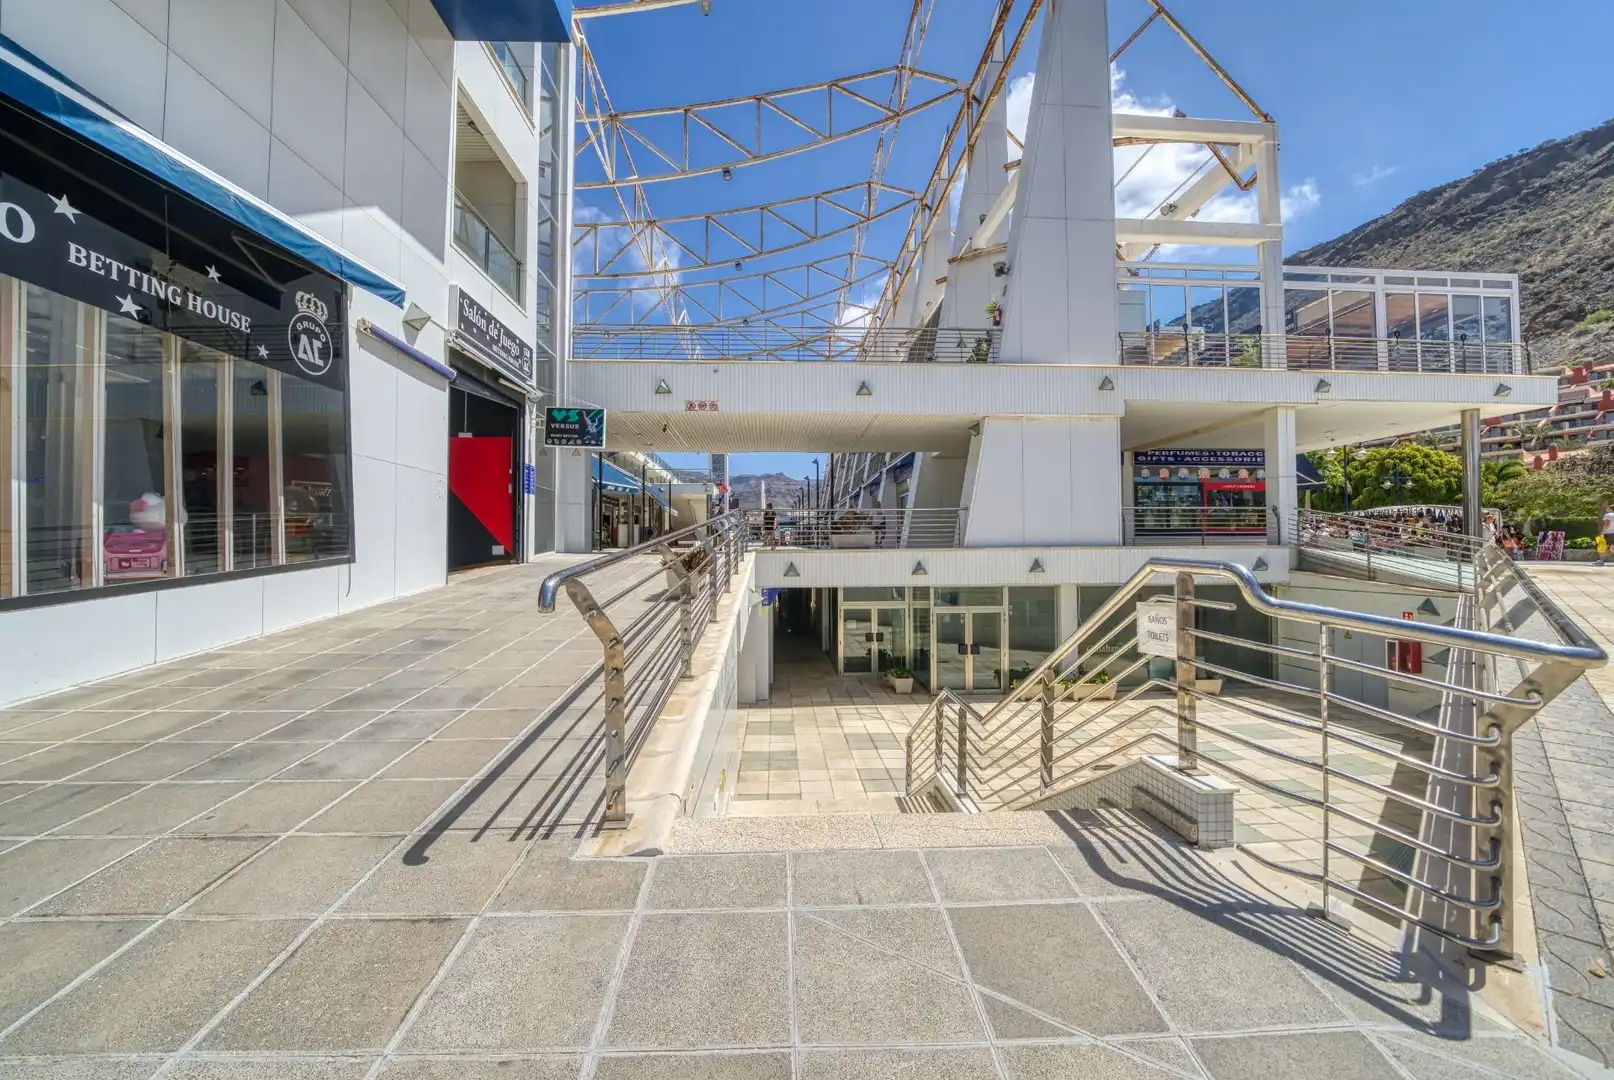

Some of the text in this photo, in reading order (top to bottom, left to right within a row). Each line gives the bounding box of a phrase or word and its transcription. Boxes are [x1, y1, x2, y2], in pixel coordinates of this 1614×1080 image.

[67, 241, 251, 334] BETTING HOUSE
[296, 320, 326, 342] GRUPO
[463, 298, 520, 357] Salón de Juego
[297, 333, 325, 367] AC
[551, 408, 580, 422] VS
[1147, 614, 1168, 626] BAÑOS
[1146, 630, 1170, 642] TOILETS
